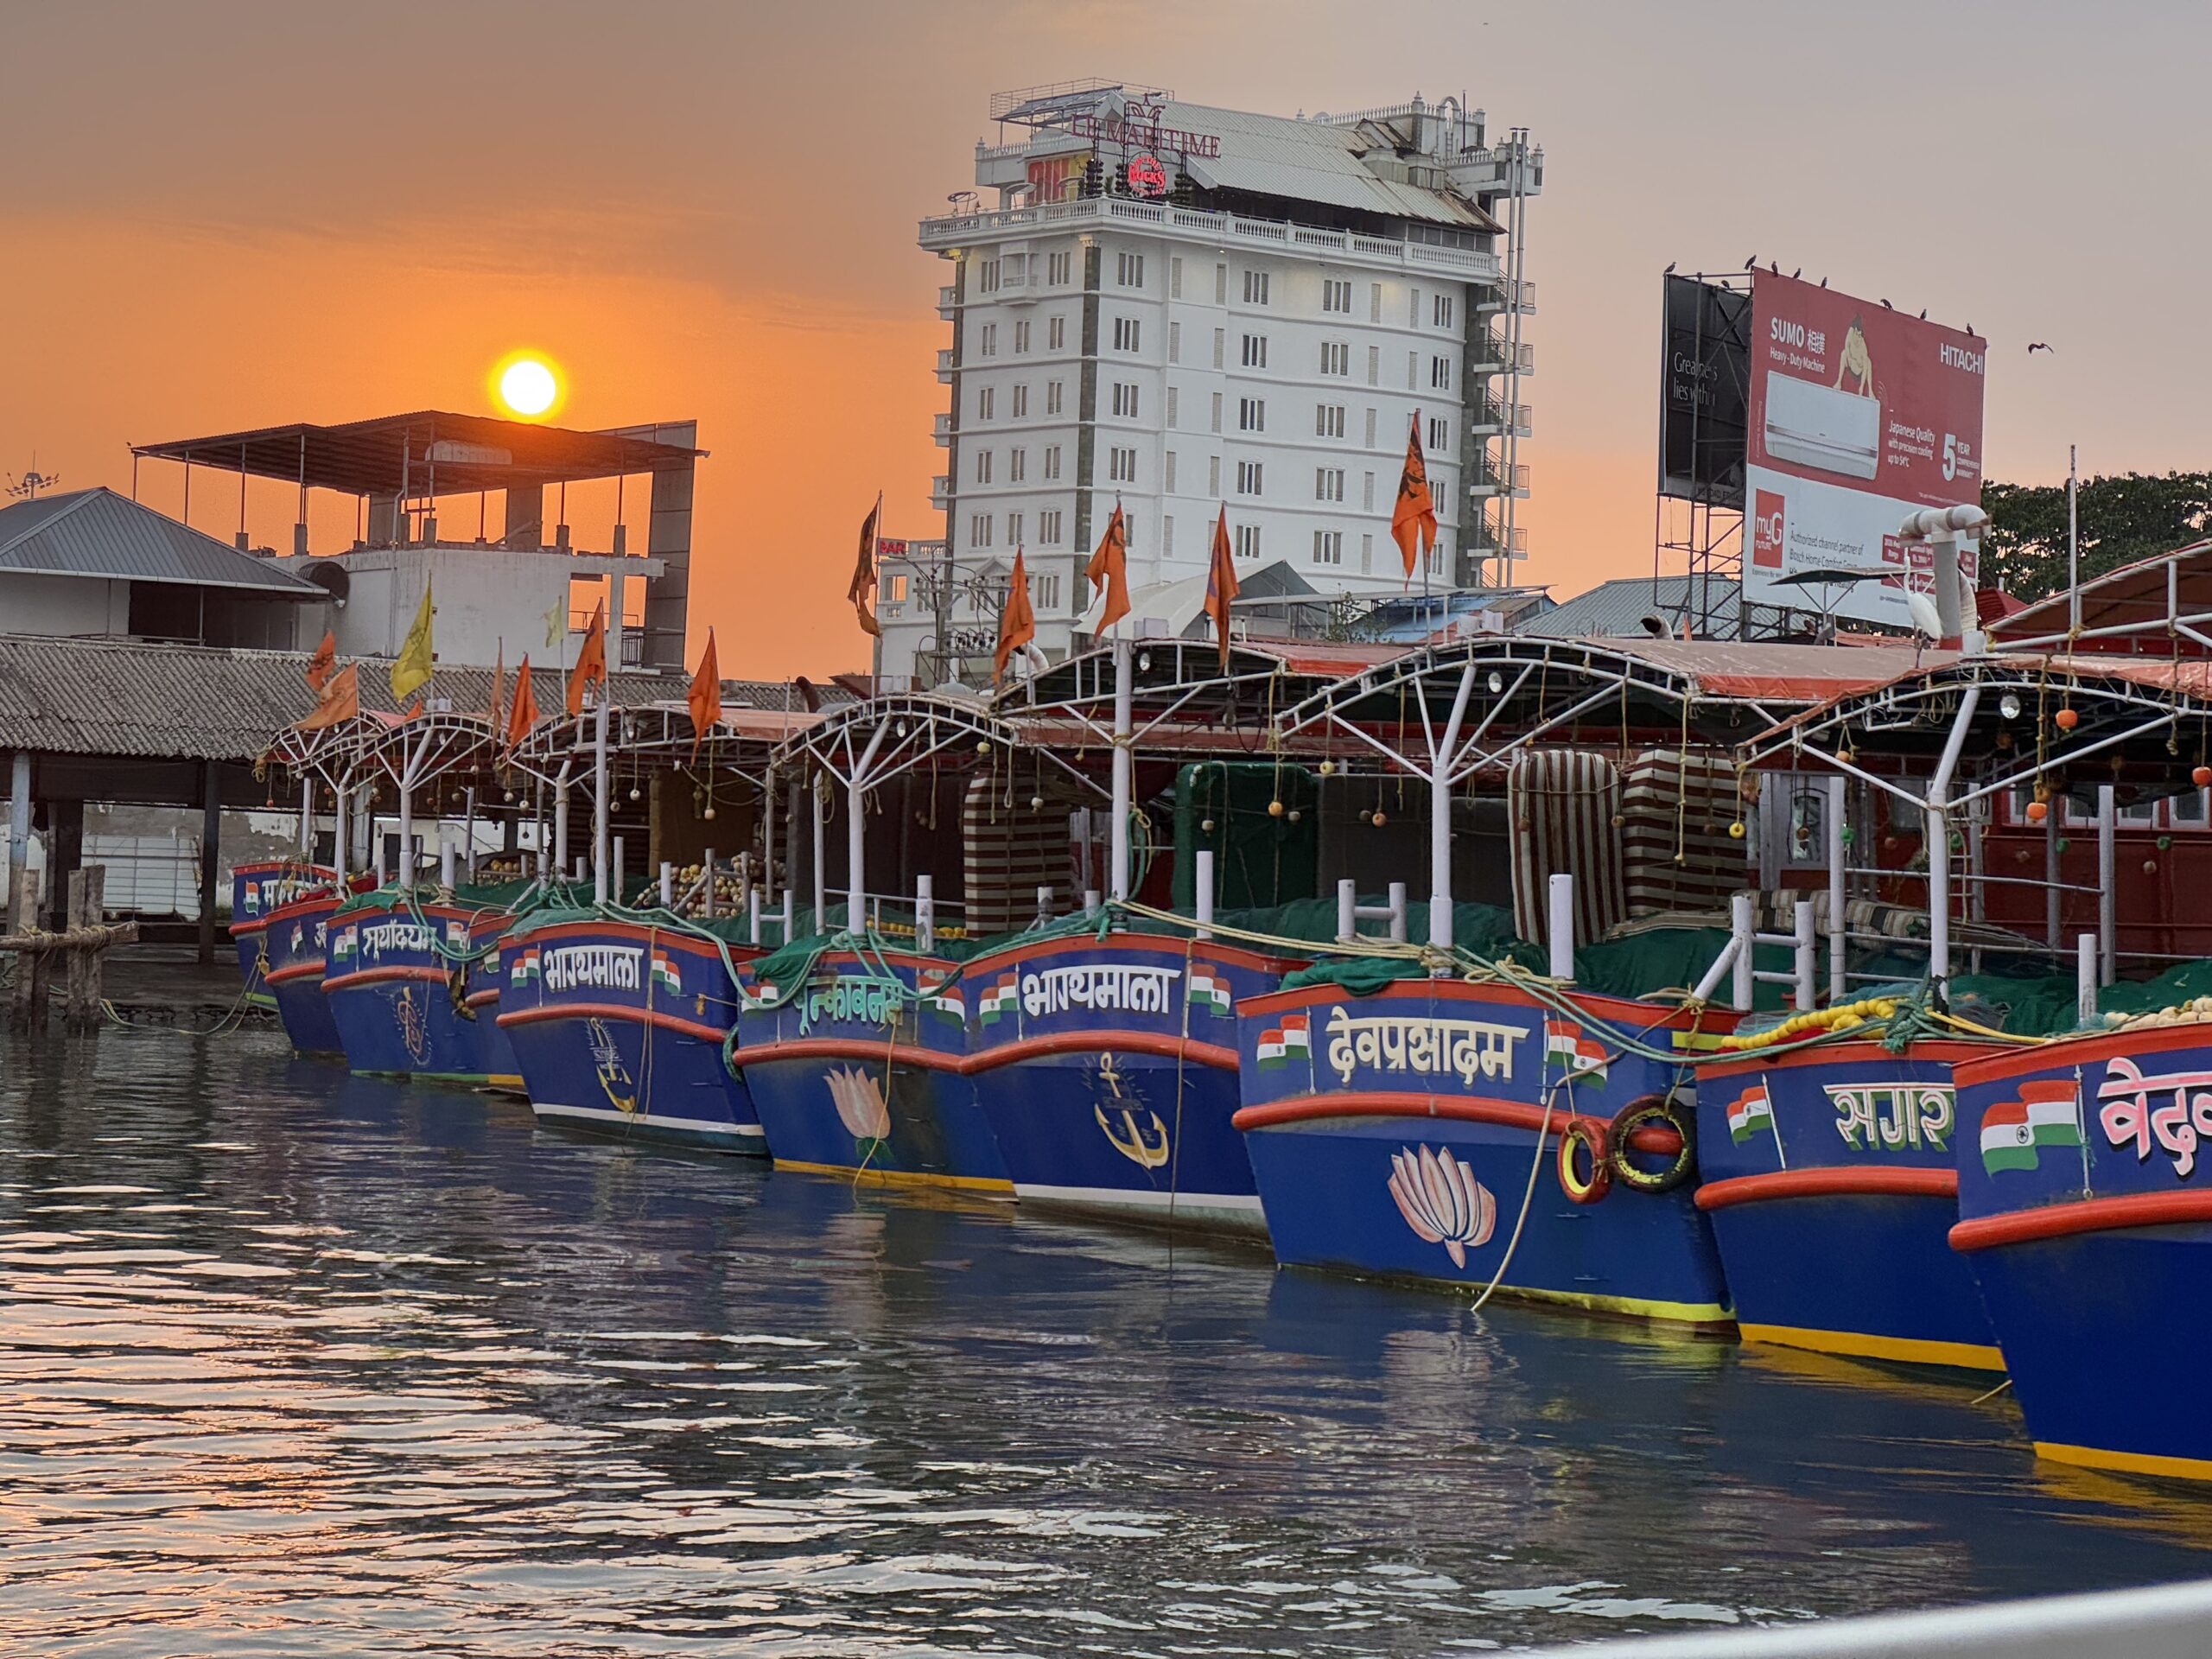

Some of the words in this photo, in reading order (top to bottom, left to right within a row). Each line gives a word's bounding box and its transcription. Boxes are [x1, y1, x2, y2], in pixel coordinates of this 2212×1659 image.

[1071, 114, 1099, 141] LE
[1106, 119, 1222, 158] MARITIME
[1128, 166, 1165, 187] ROCKS
[1770, 316, 1805, 348] SUMO
[1770, 346, 1787, 365] Heavy
[1790, 353, 1803, 370] Duty
[1803, 356, 1825, 374] Machine
[1940, 342, 1984, 375] HITACHI
[1673, 377, 1688, 402] lies
[1888, 420, 1916, 438] Japanese
[1916, 427, 1936, 446] Quality
[1942, 433, 1956, 481] 5
[1956, 441, 1971, 456] YEAR
[1756, 512, 1783, 545] myG
[880, 541, 905, 555] BAR
[1790, 529, 1818, 548] Authorized
[1818, 536, 1839, 551] channel
[1839, 542, 1858, 555] partner
[1789, 548, 1805, 563] Bosch
[1805, 553, 1821, 566] Home
